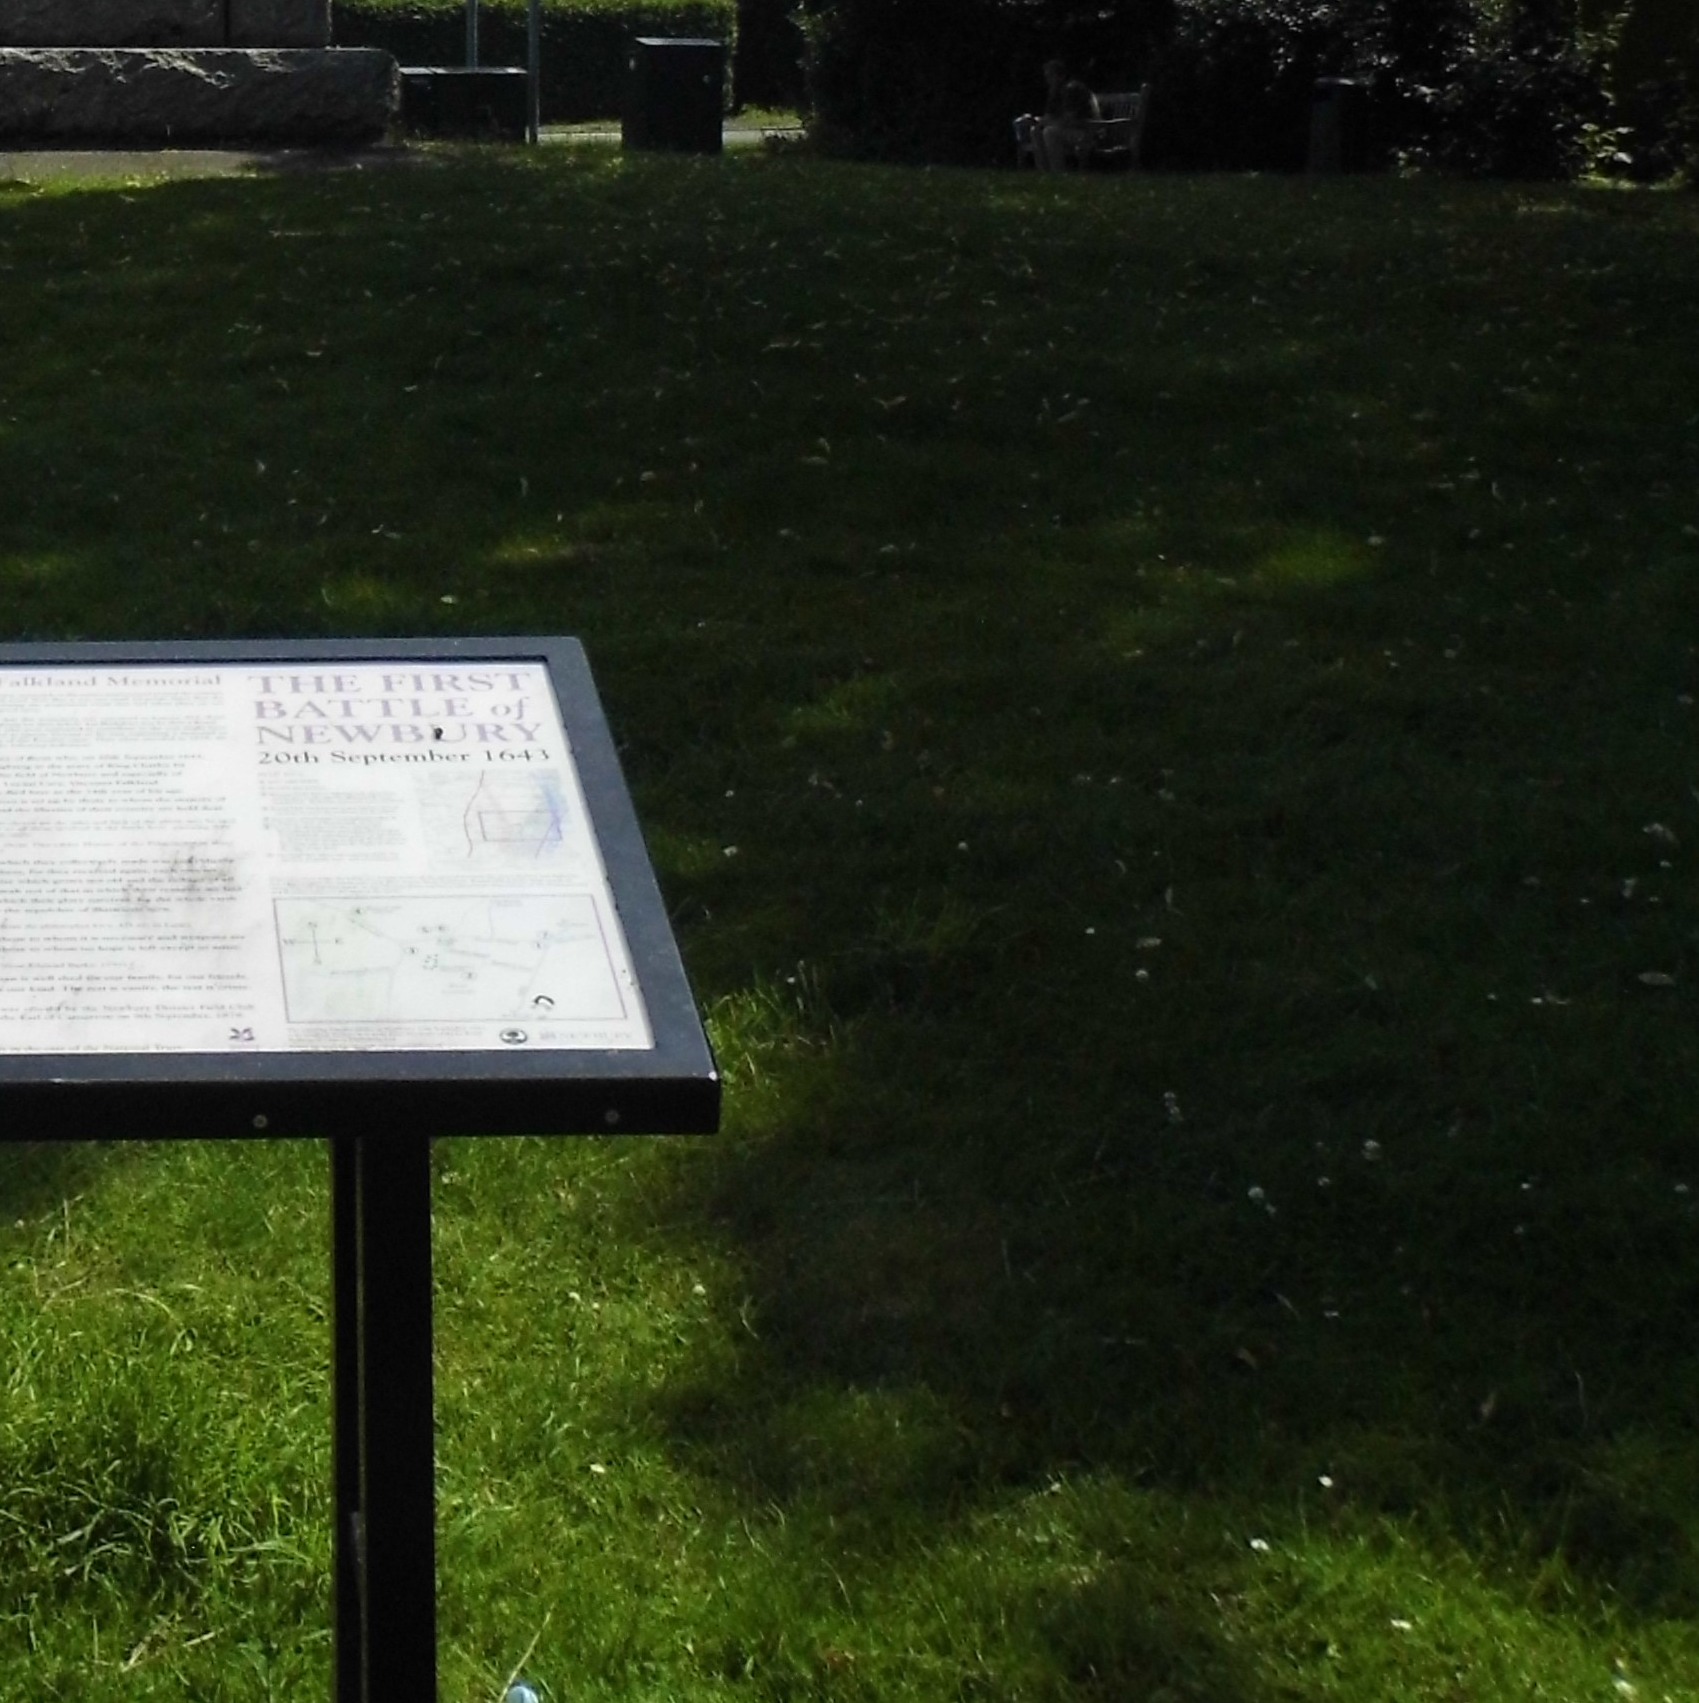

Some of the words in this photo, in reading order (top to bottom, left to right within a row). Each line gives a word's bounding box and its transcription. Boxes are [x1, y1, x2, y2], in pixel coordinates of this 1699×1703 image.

[107, 674, 221, 687] Memorial
[248, 673, 362, 694] THE
[382, 672, 531, 693] FIRST
[254, 698, 474, 720] BATTLE
[490, 696, 531, 721] of
[256, 723, 541, 745] NEWBURY
[258, 750, 319, 765] 20th
[331, 749, 470, 766] September
[484, 749, 550, 763] 1643
